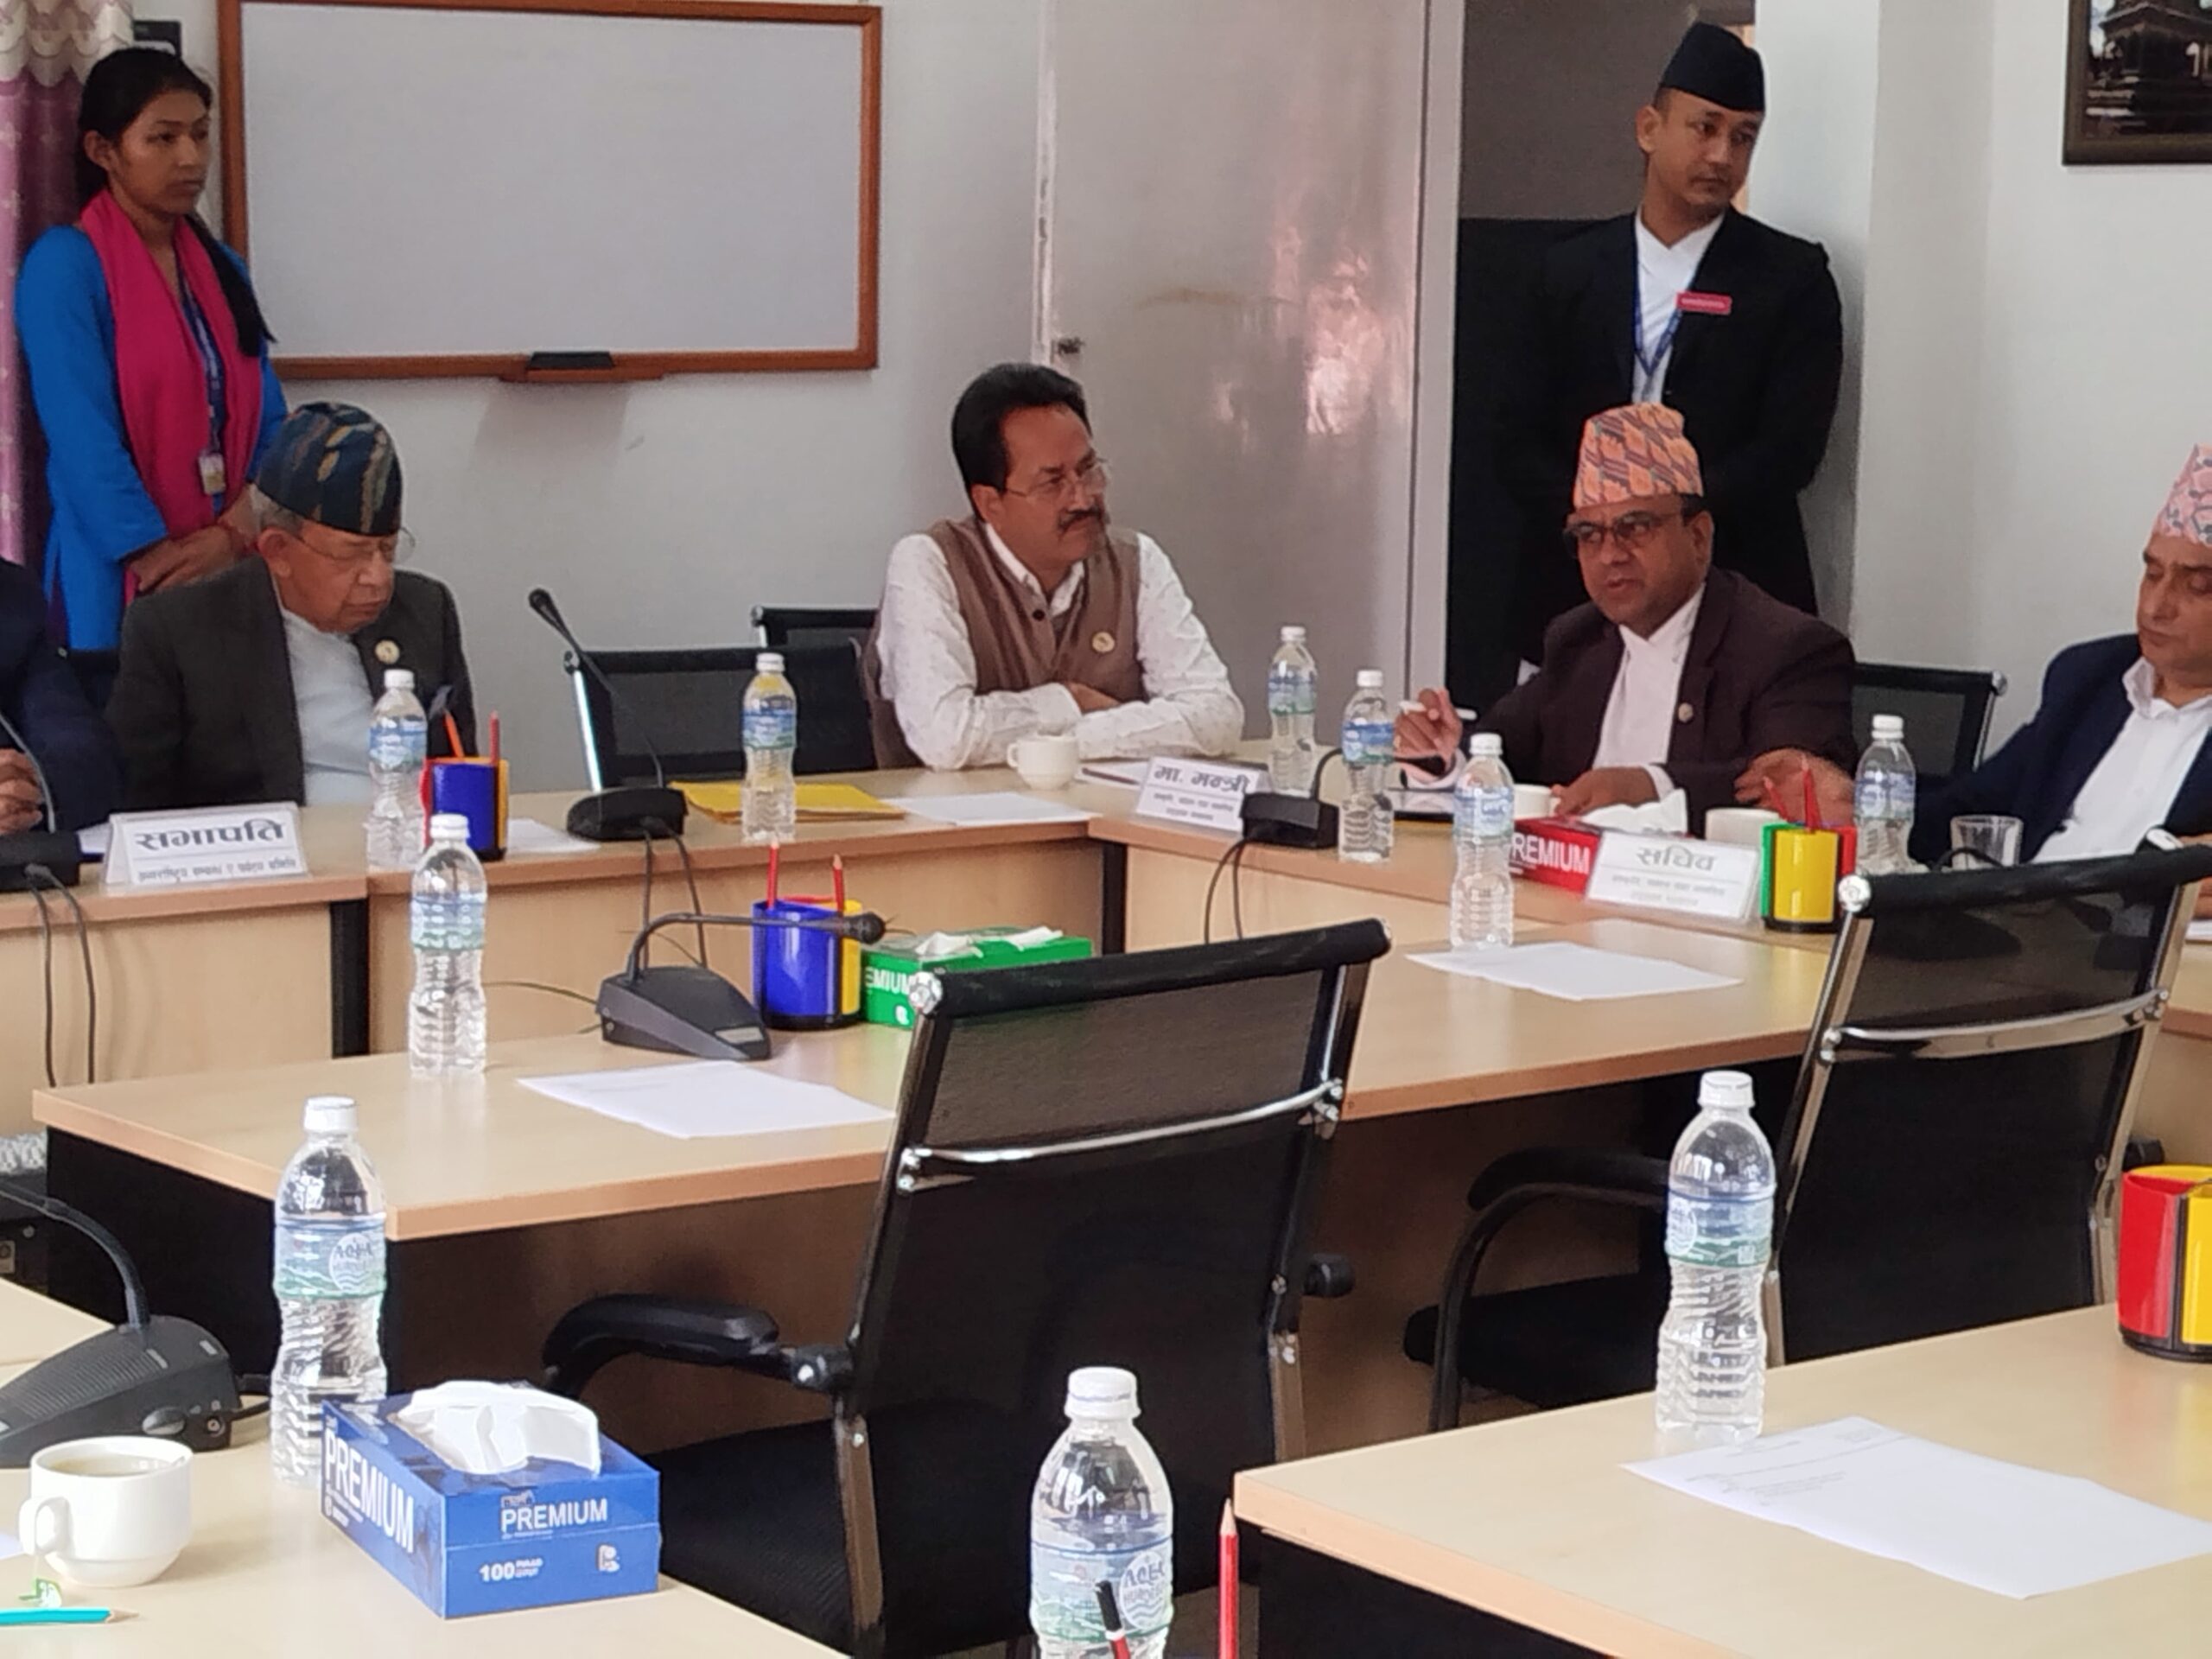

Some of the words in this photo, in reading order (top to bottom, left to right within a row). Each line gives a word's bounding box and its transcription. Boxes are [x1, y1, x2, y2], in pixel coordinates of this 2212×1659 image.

[134, 817, 286, 851] सभापति
[1511, 832, 1590, 874] REMIUM
[1636, 843, 1718, 872] सचिव
[865, 966, 910, 995] EMIUM
[325, 1428, 415, 1554] PREMIUM
[501, 1497, 608, 1534] PREMIUM
[480, 1561, 516, 1583] 100
